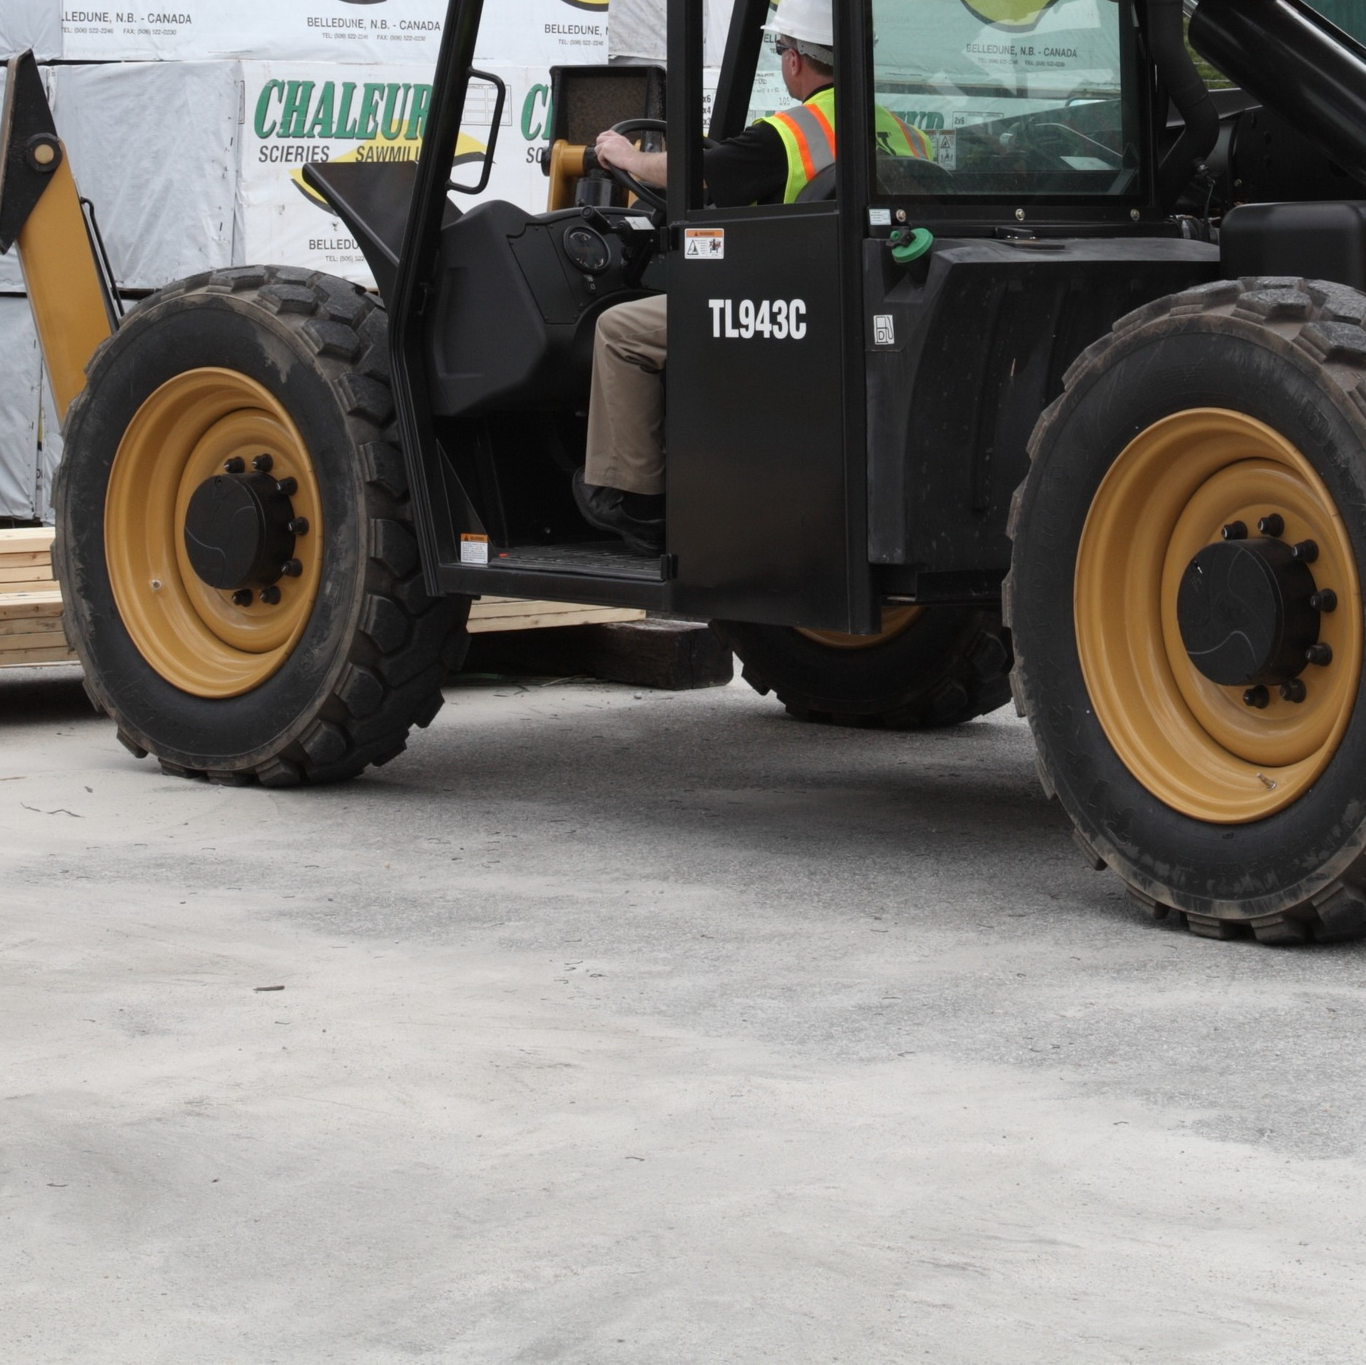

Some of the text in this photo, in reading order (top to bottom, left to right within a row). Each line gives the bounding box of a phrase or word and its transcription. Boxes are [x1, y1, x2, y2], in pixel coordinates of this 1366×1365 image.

[116, 13, 137, 23] N.B.
[147, 13, 192, 24] CANADA
[307, 17, 441, 31] BELLEDUNE, N.B. CANADA
[545, 23, 603, 36] BELLEDUNE,
[966, 44, 1077, 58] BELLEDUNE, N.B. CANADA
[259, 145, 330, 163] SCIERIES
[709, 299, 807, 339] TL943C
